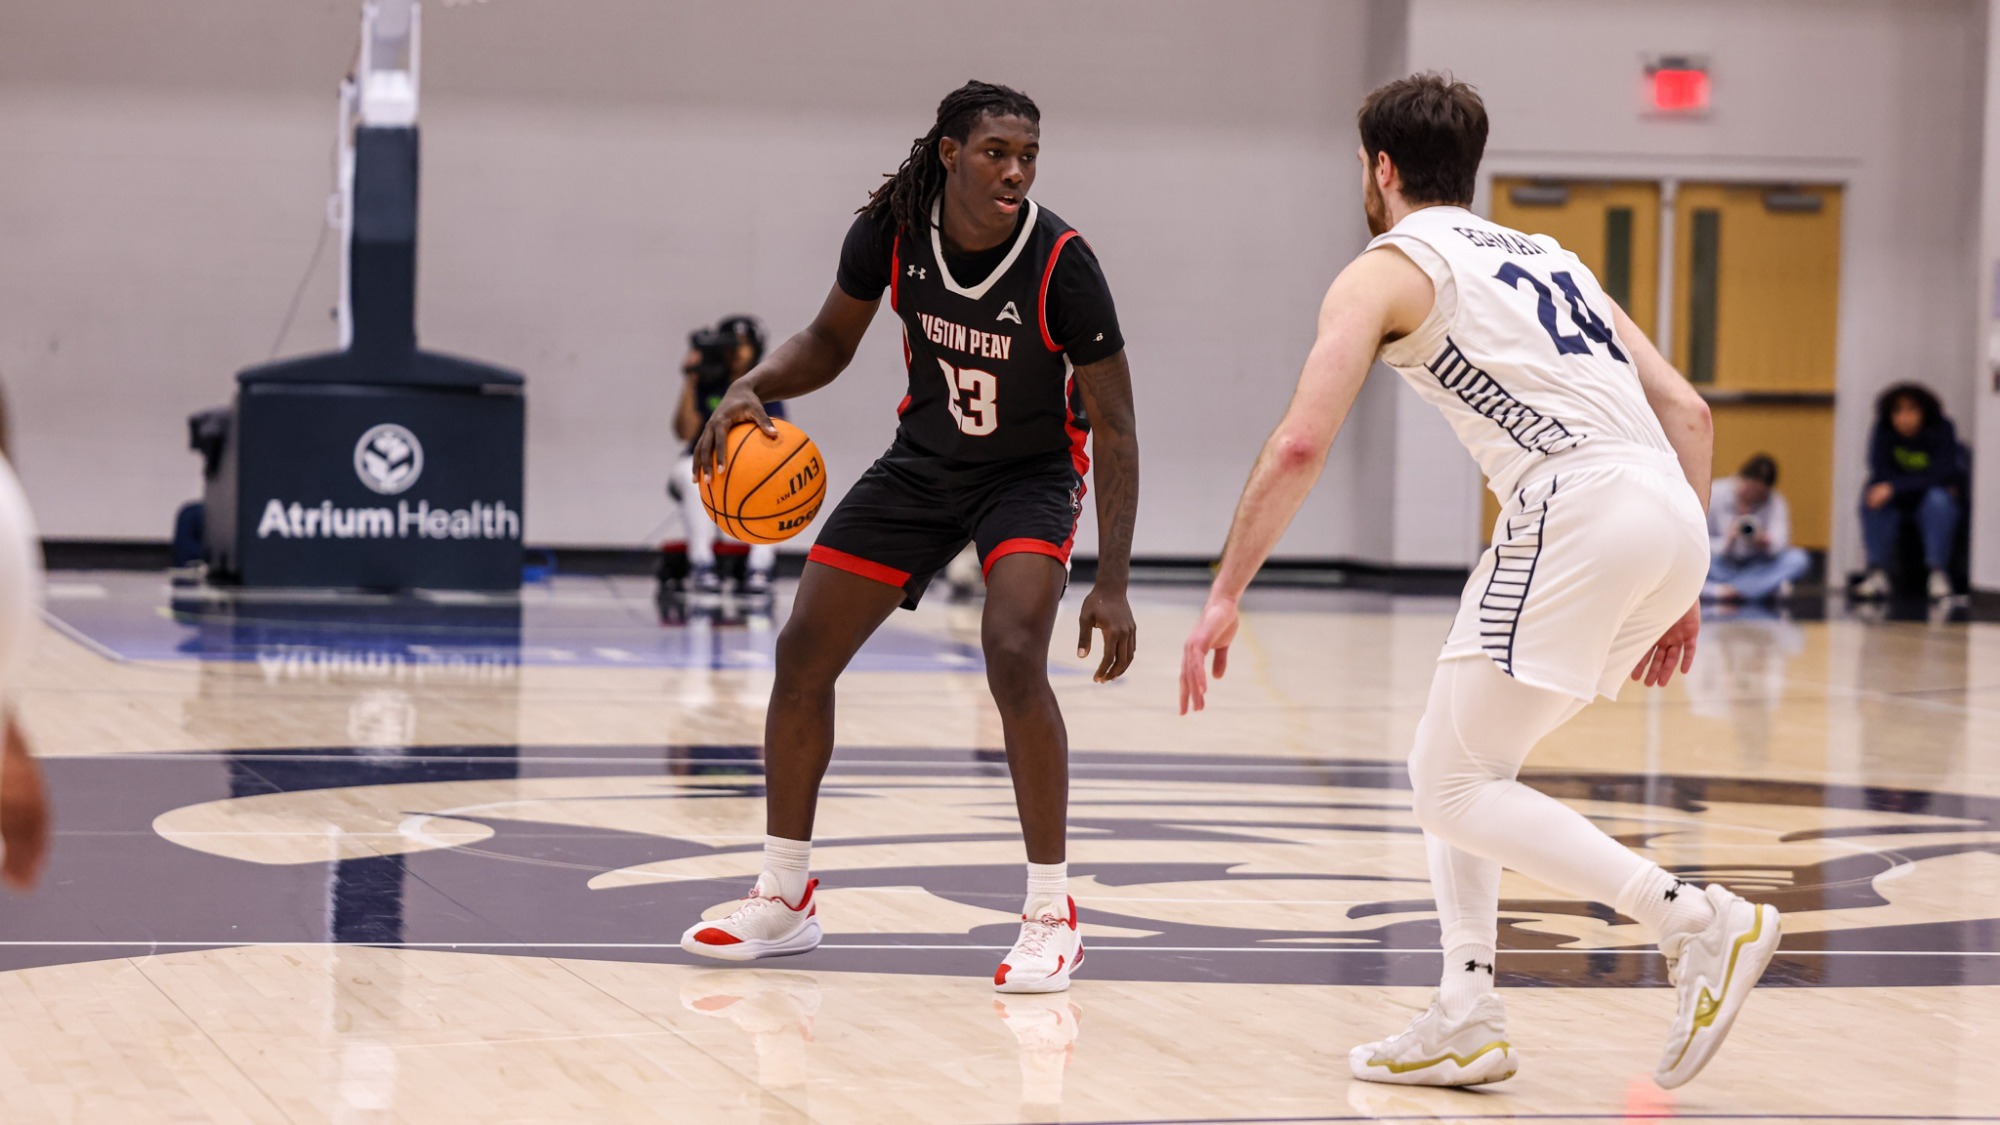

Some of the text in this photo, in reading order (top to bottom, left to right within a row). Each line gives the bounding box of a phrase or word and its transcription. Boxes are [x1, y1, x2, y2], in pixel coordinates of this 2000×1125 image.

[916, 311, 1012, 361] USTIN PEAY
[1489, 261, 1630, 365] 24
[257, 498, 520, 540] Atrium Health
[778, 502, 823, 531] son
